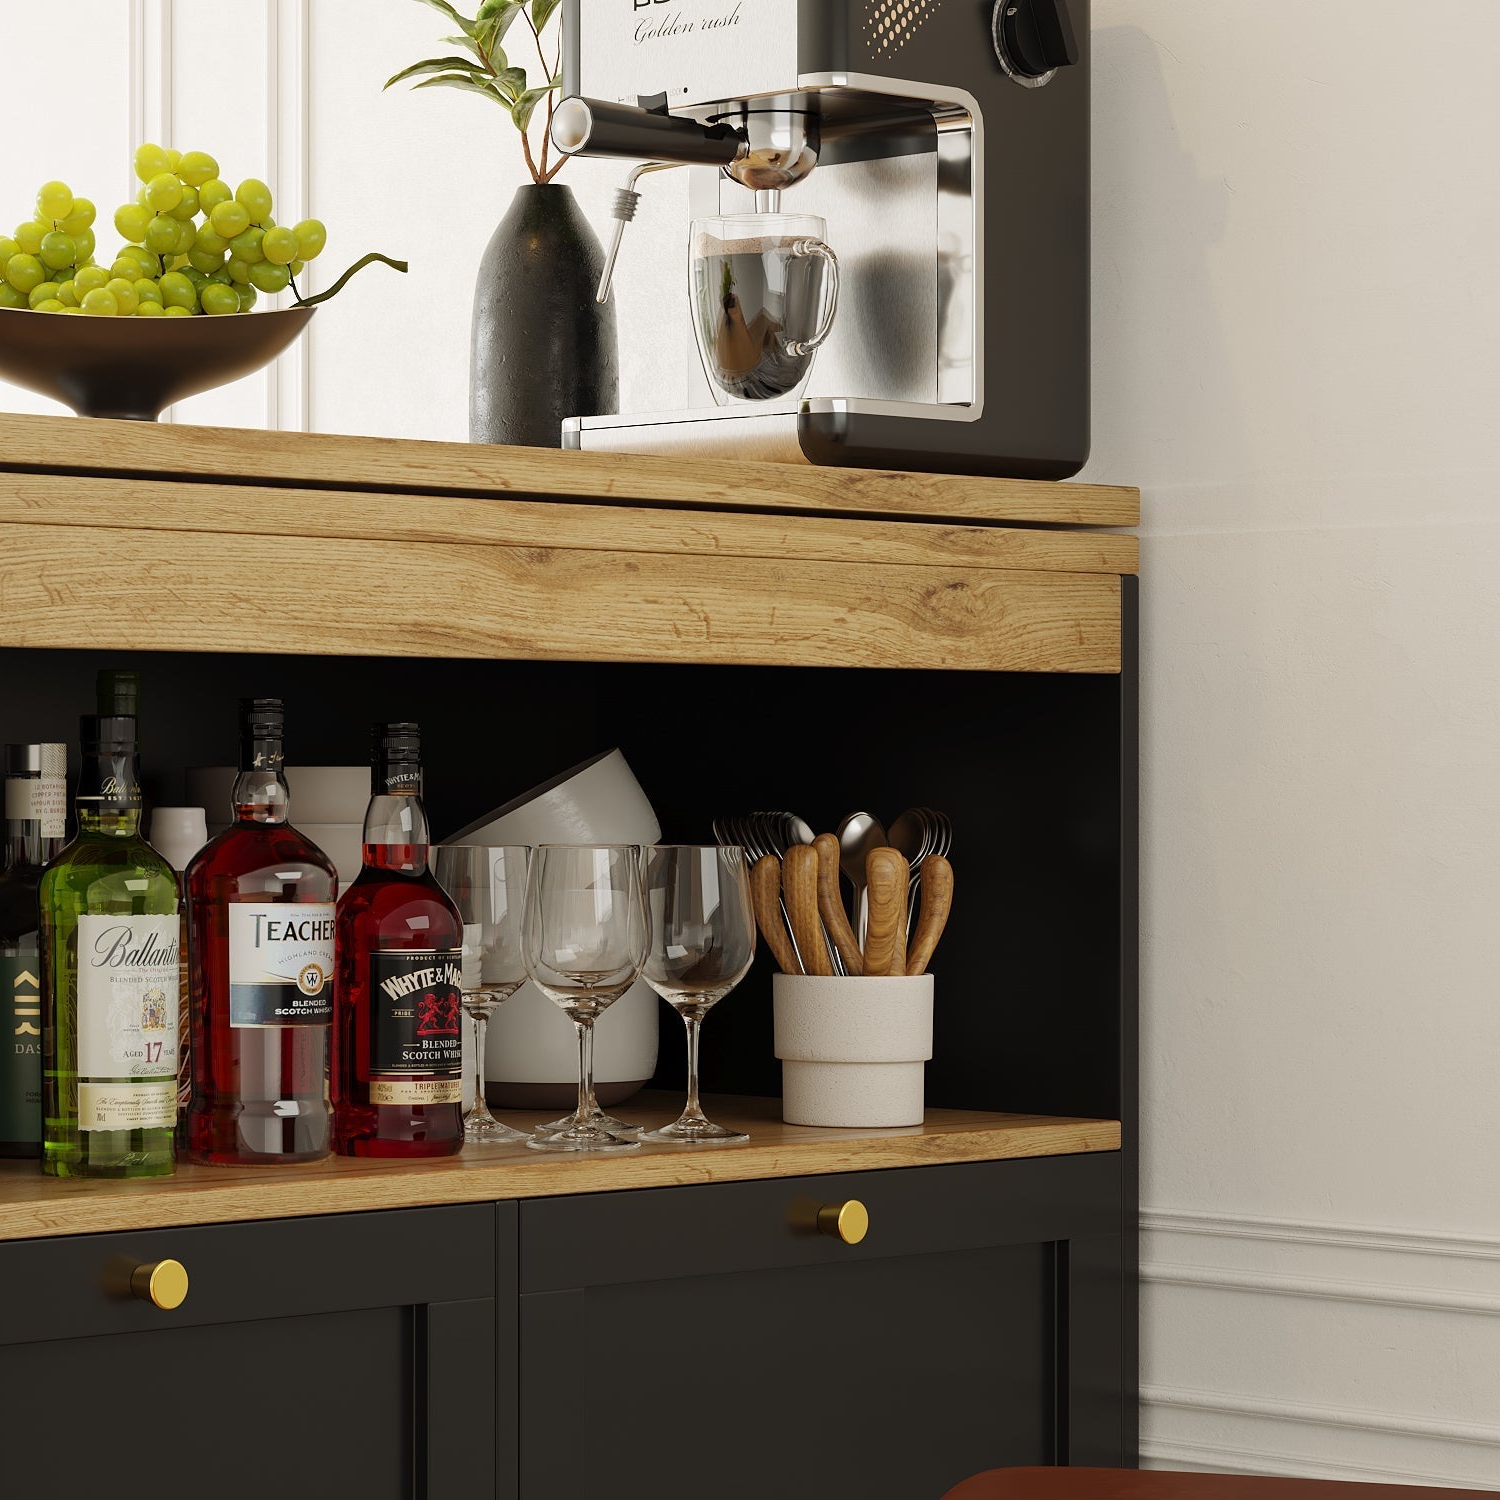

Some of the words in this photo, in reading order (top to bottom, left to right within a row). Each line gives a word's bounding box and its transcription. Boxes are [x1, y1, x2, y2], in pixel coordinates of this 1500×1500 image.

[634, 11, 695, 45] Golden
[701, 2, 742, 30] rush
[249, 914, 335, 948] TEACHER
[278, 951, 317, 965] HIGHLAND
[292, 999, 326, 1007] BLENDED
[422, 1040, 457, 1049] BLENDED
[144, 1041, 163, 1063] 17
[402, 1051, 441, 1060] SCOTCH
